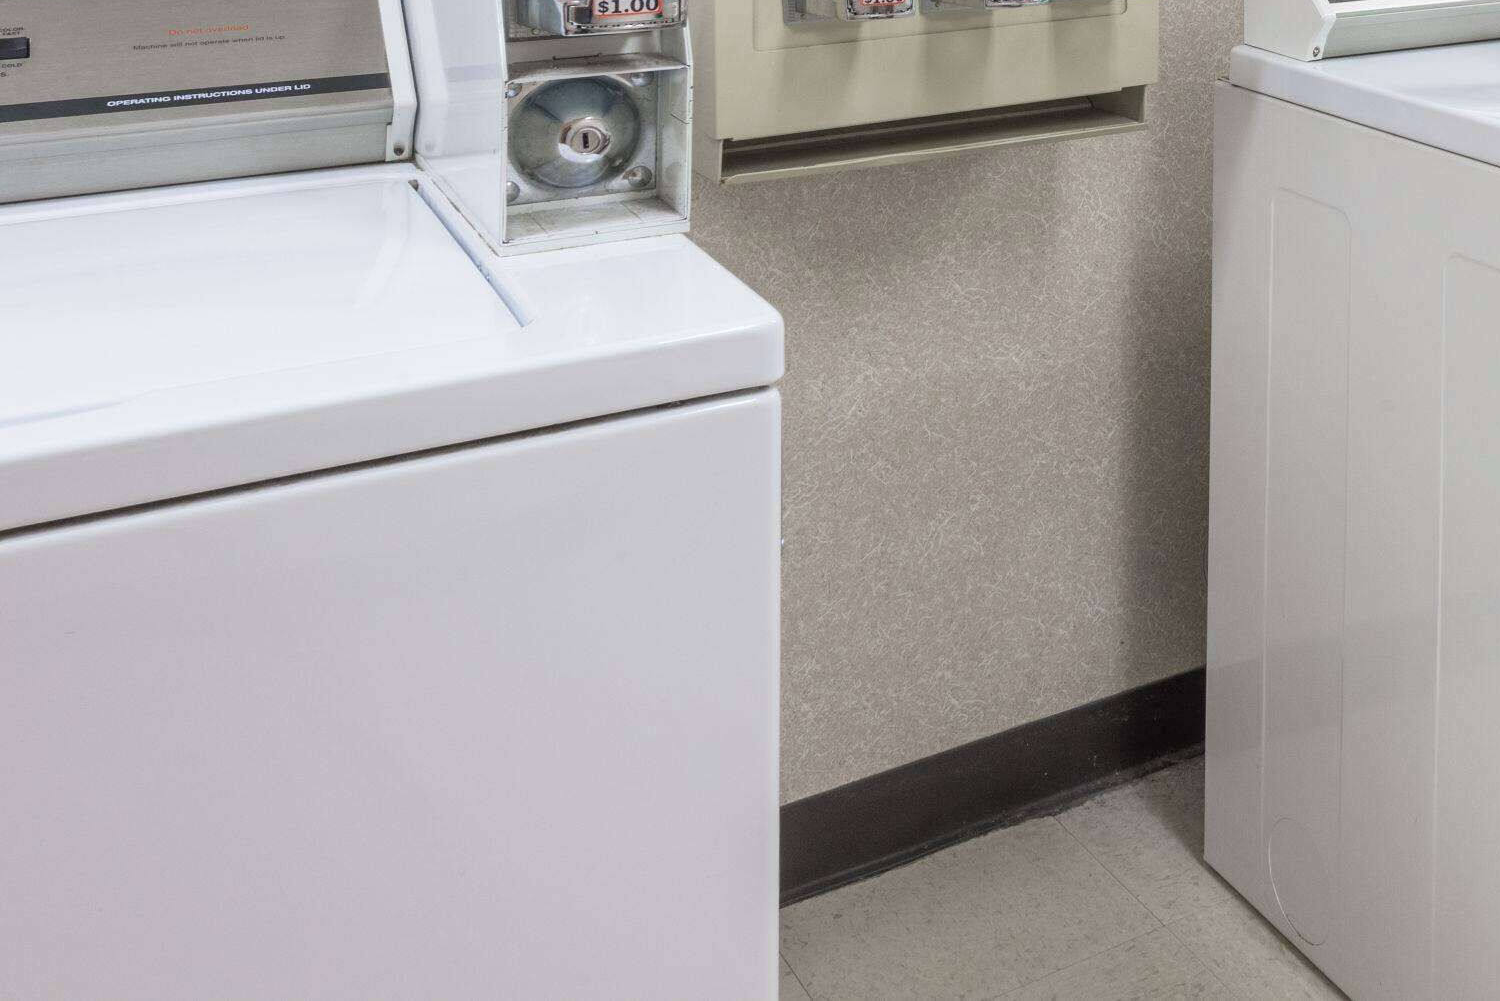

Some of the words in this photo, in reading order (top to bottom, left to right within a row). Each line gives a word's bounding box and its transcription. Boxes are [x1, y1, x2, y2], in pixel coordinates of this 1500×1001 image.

[107, 95, 171, 107] OPERATING
[173, 88, 253, 101] INSTRUCTIONS
[254, 85, 292, 94] UNDER
